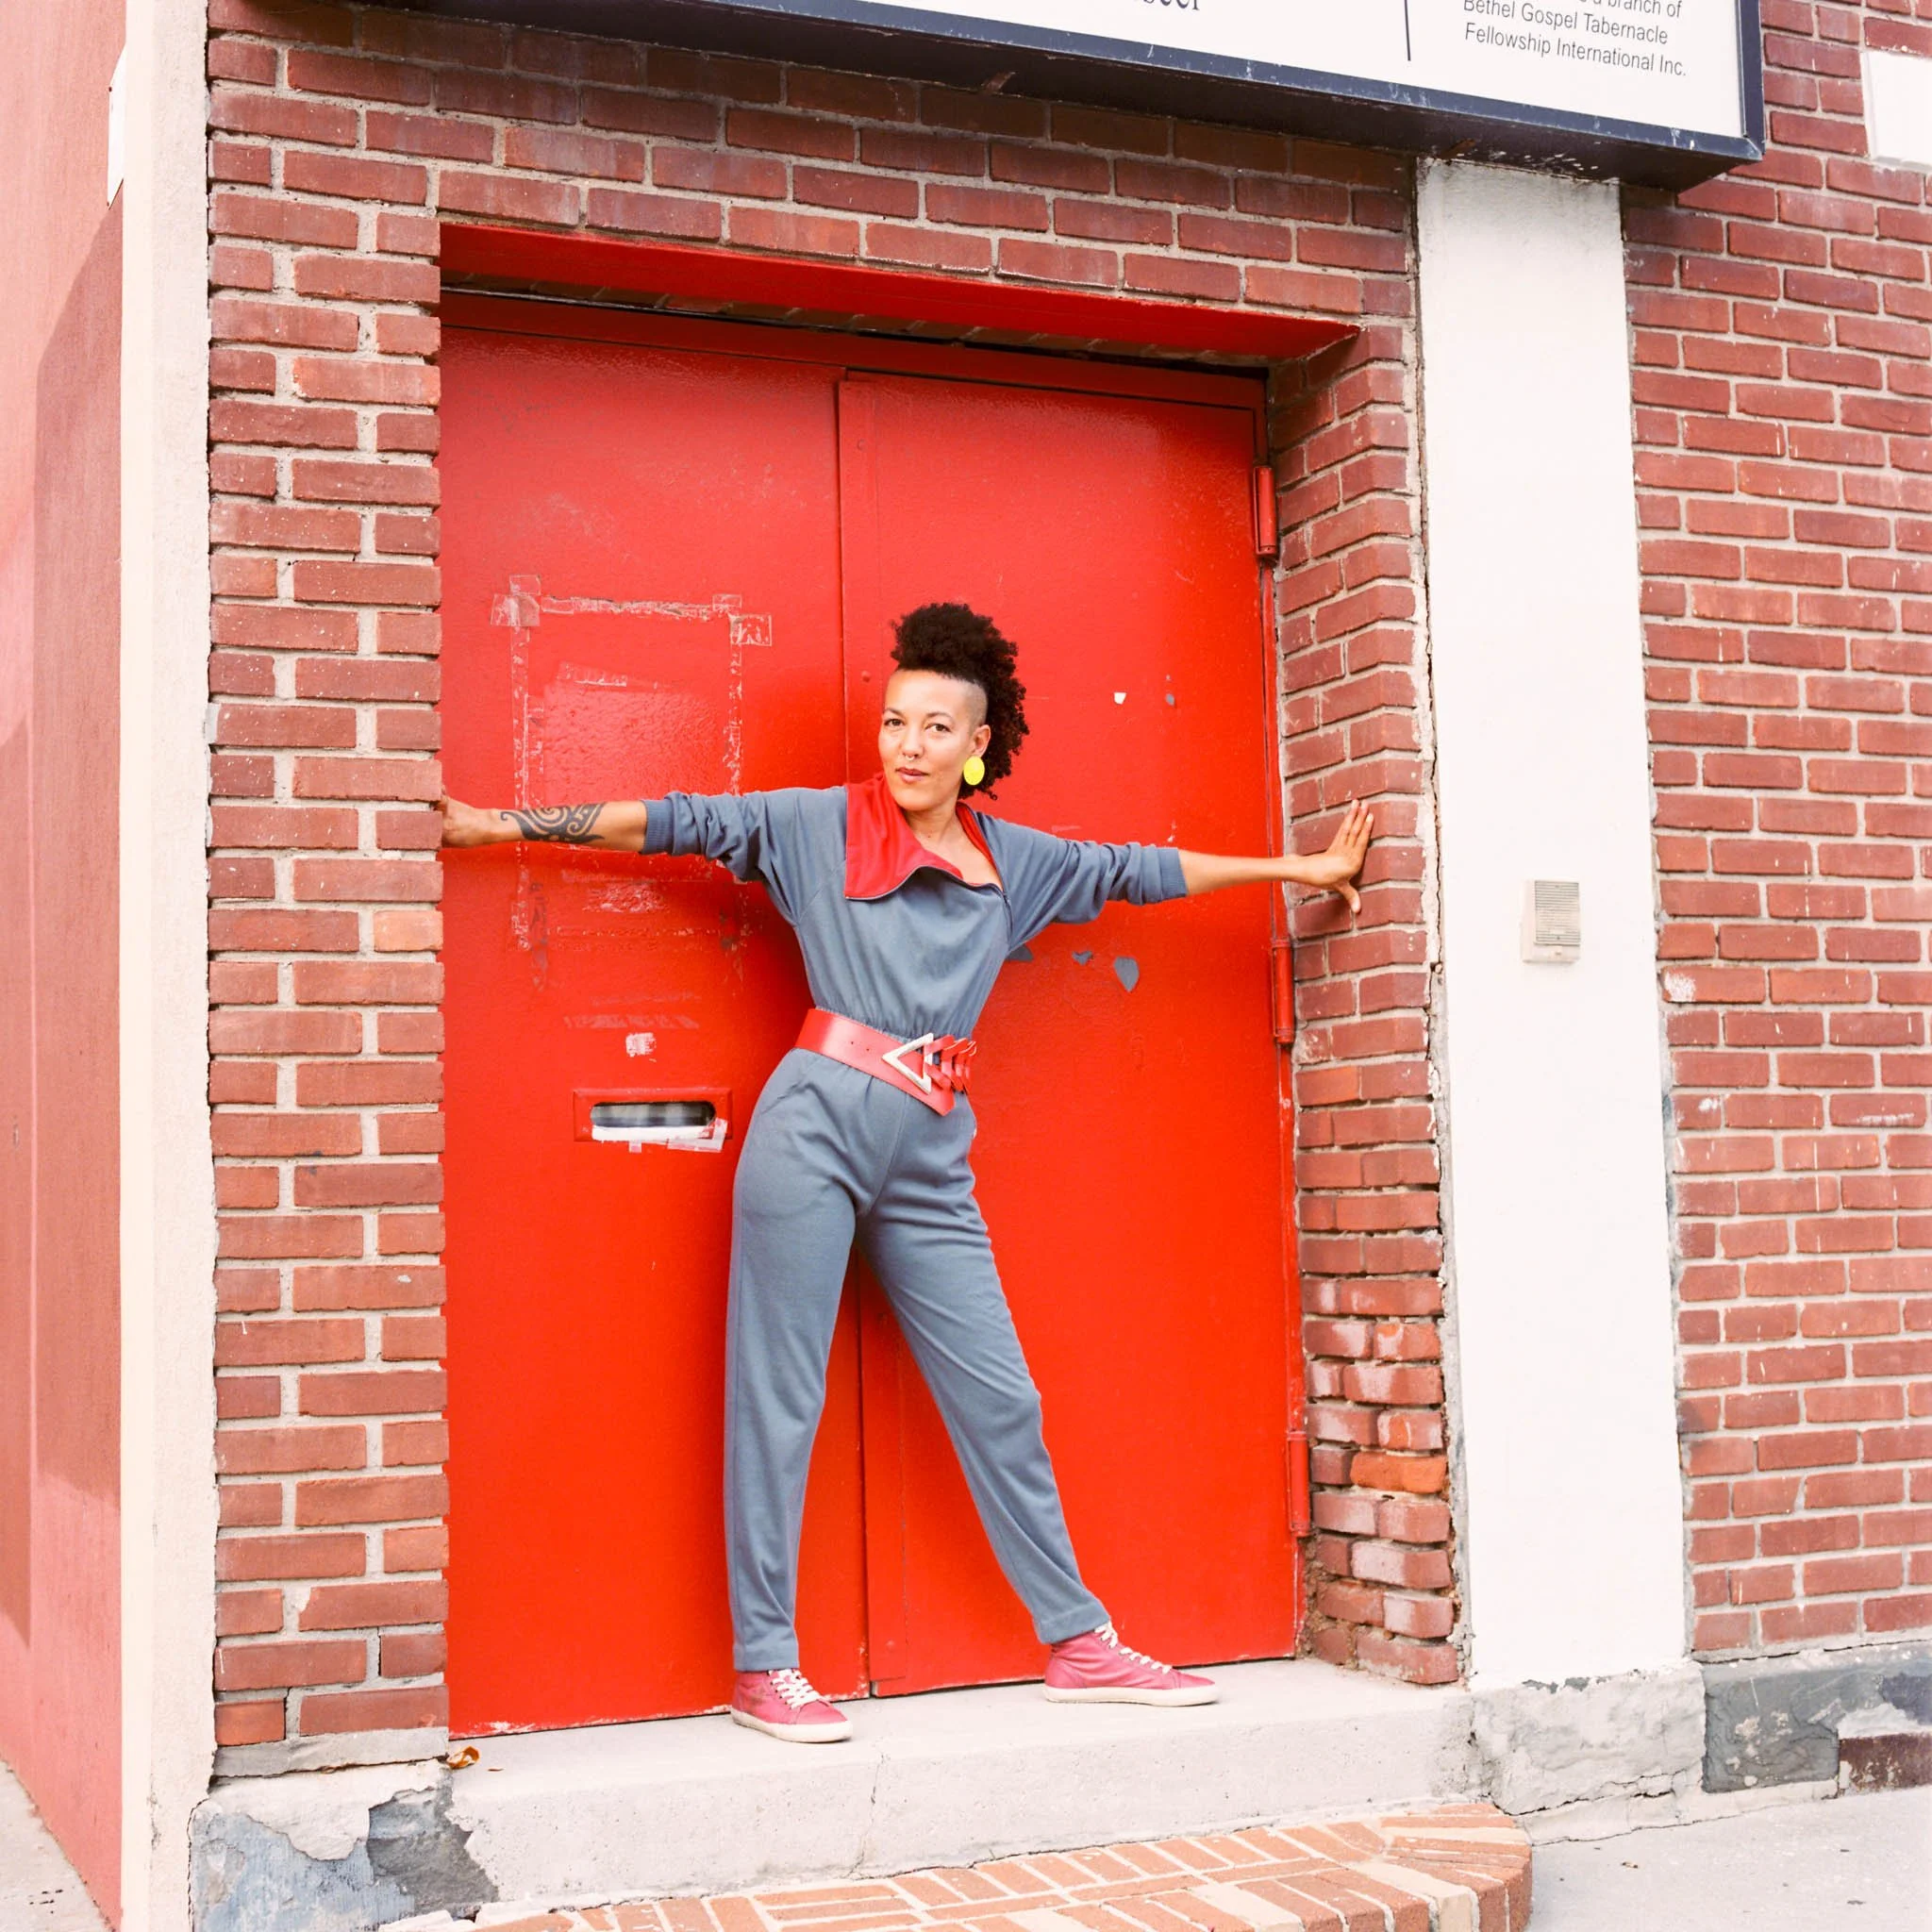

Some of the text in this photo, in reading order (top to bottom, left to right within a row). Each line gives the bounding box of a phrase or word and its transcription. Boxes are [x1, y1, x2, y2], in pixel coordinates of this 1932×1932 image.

[1463, 0, 1669, 45] Bethel Gospel Tabernacle
[1666, 0, 1682, 18] of
[1464, 22, 1687, 77] Fellowship International Inc.
